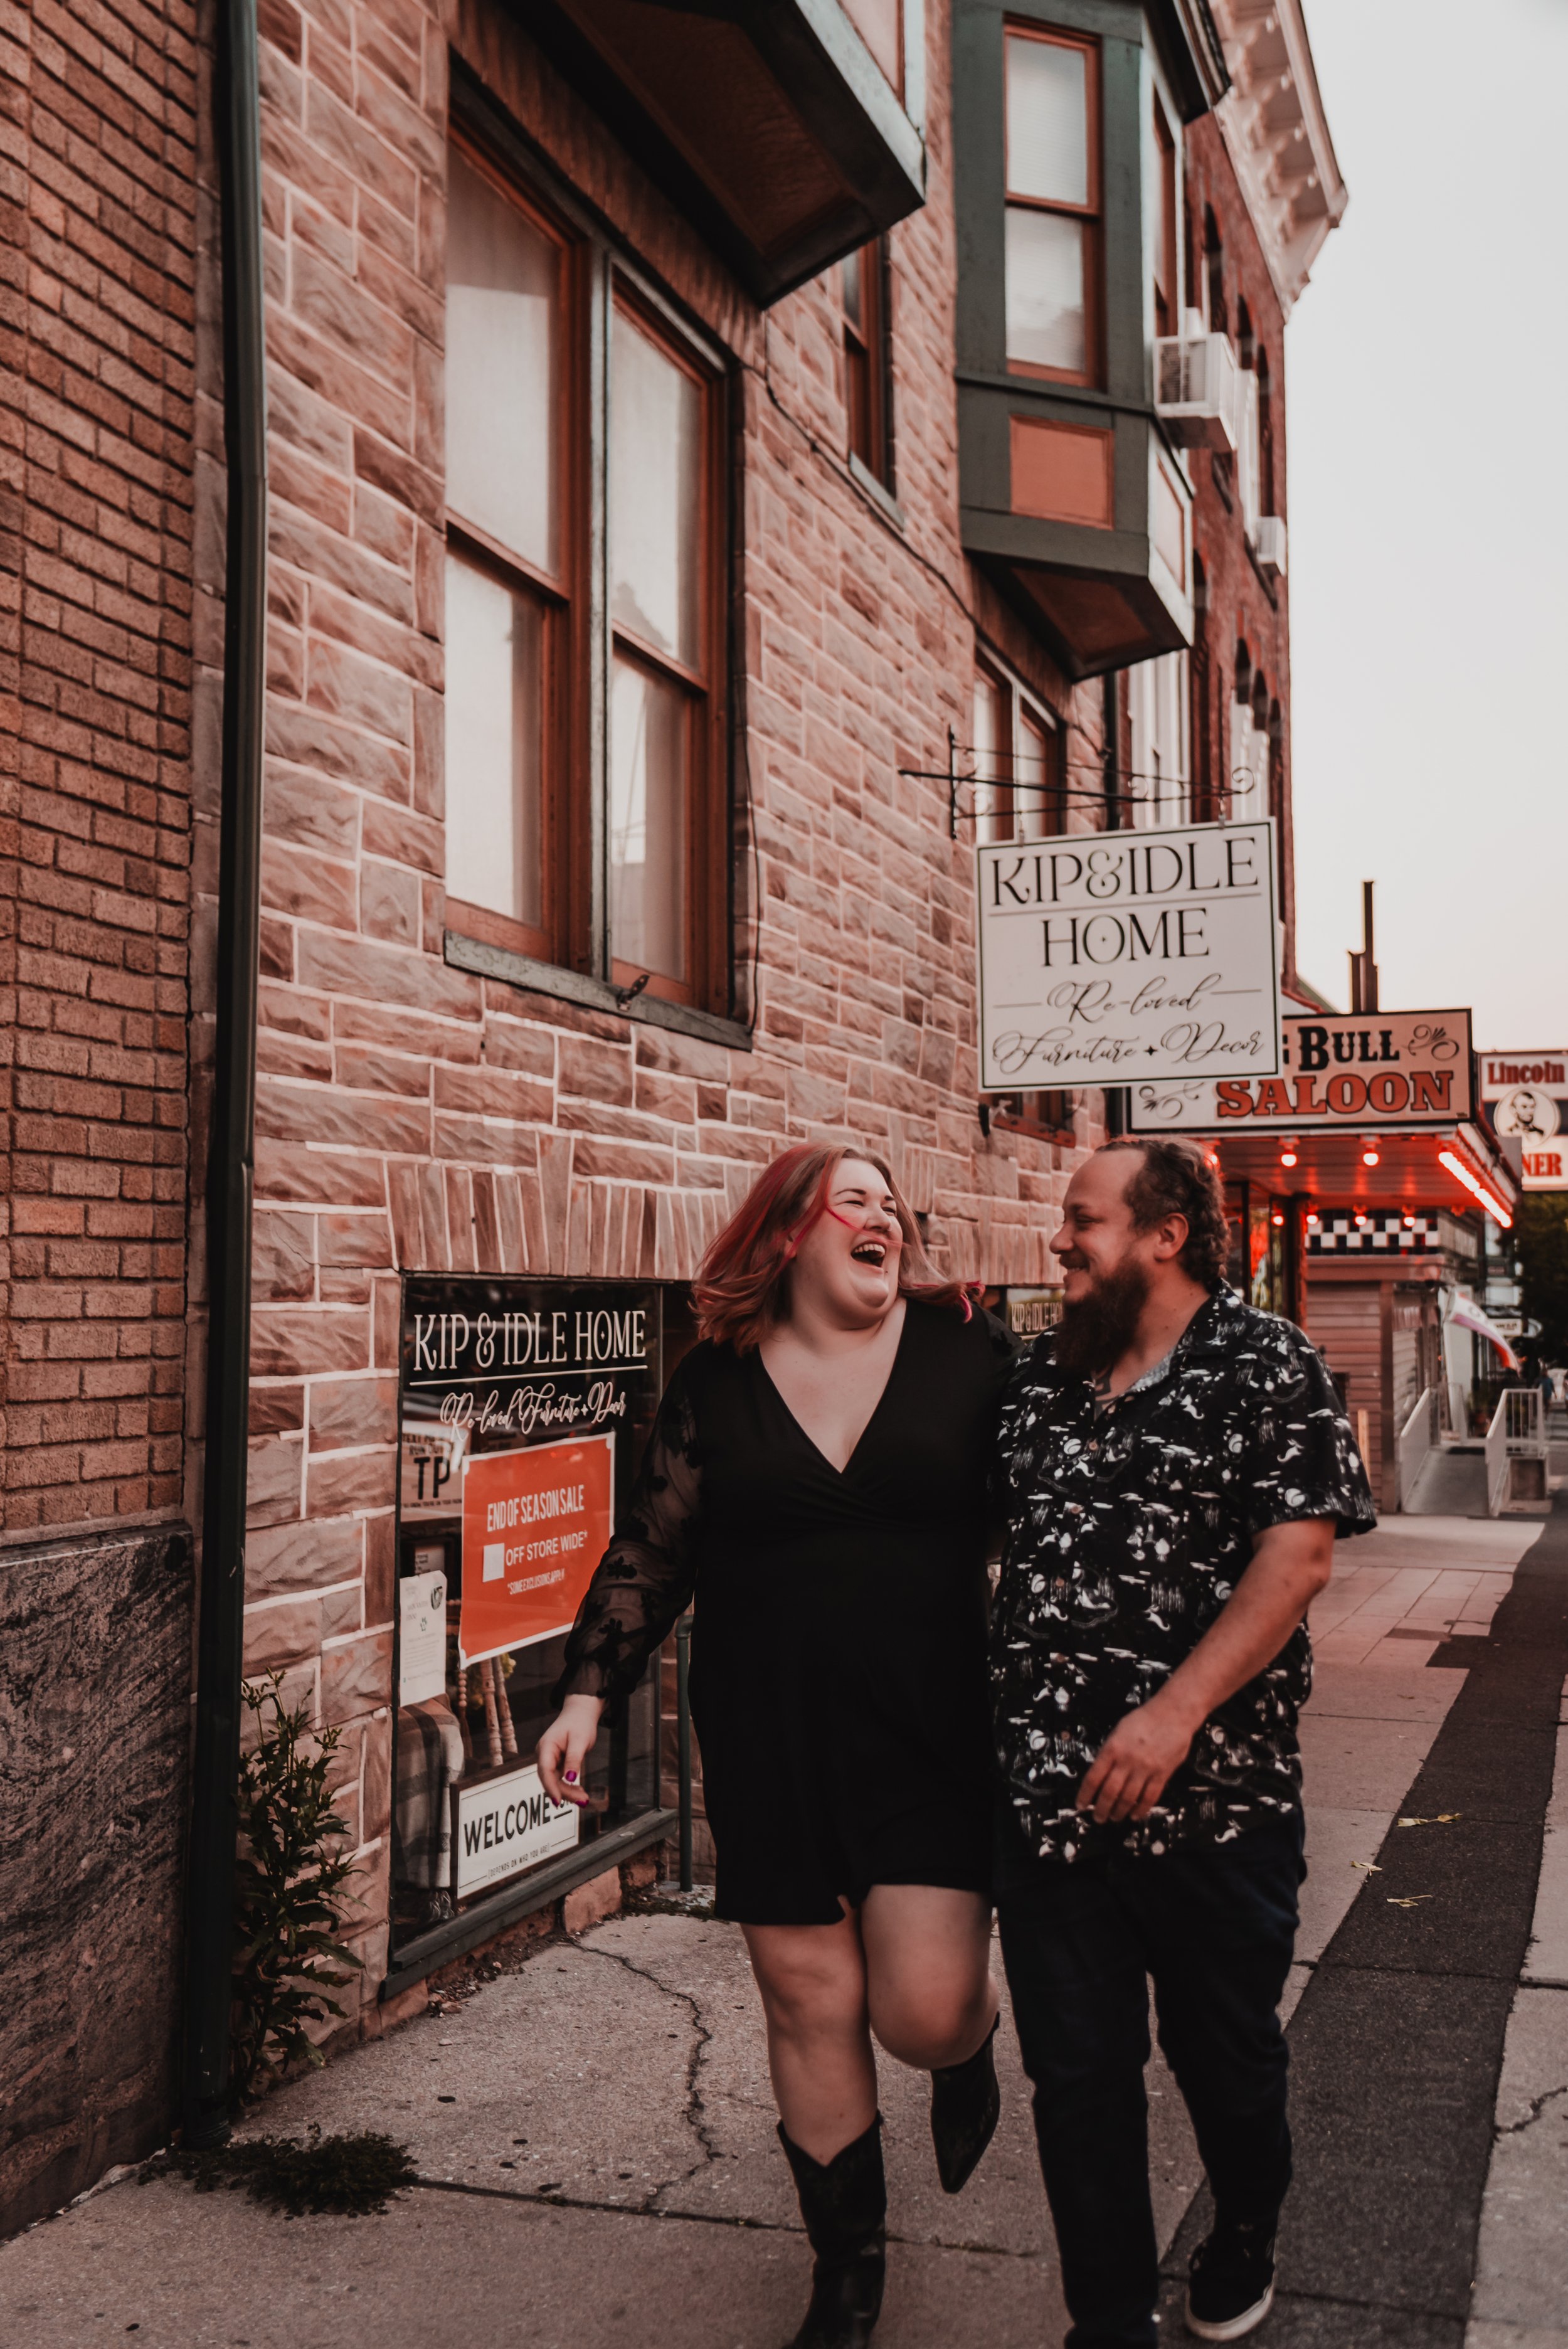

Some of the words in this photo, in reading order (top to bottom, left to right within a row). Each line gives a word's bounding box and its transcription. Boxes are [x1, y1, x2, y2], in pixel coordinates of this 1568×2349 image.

[1040, 907, 1210, 967] HOME
[1046, 973, 1222, 1024] Re-loved
[992, 1026, 1140, 1075] Furniture
[1160, 1021, 1264, 1064] Decor
[1297, 1026, 1399, 1071] BULL
[1487, 1060, 1565, 1084] Lincoln
[1216, 1071, 1454, 1118] SALOON
[413, 1313, 470, 1371] KIP
[475, 1312, 497, 1369] &
[502, 1312, 567, 1366] IDLE
[574, 1310, 647, 1361] HOME
[413, 1456, 450, 1500] TP
[487, 1501, 506, 1532] END
[507, 1498, 520, 1527] OF
[521, 1489, 559, 1524] SEASON
[559, 1484, 585, 1515] SALE
[506, 1546, 525, 1566] OFF
[526, 1537, 559, 1561] STORE
[464, 1791, 551, 1857] WELCOME
